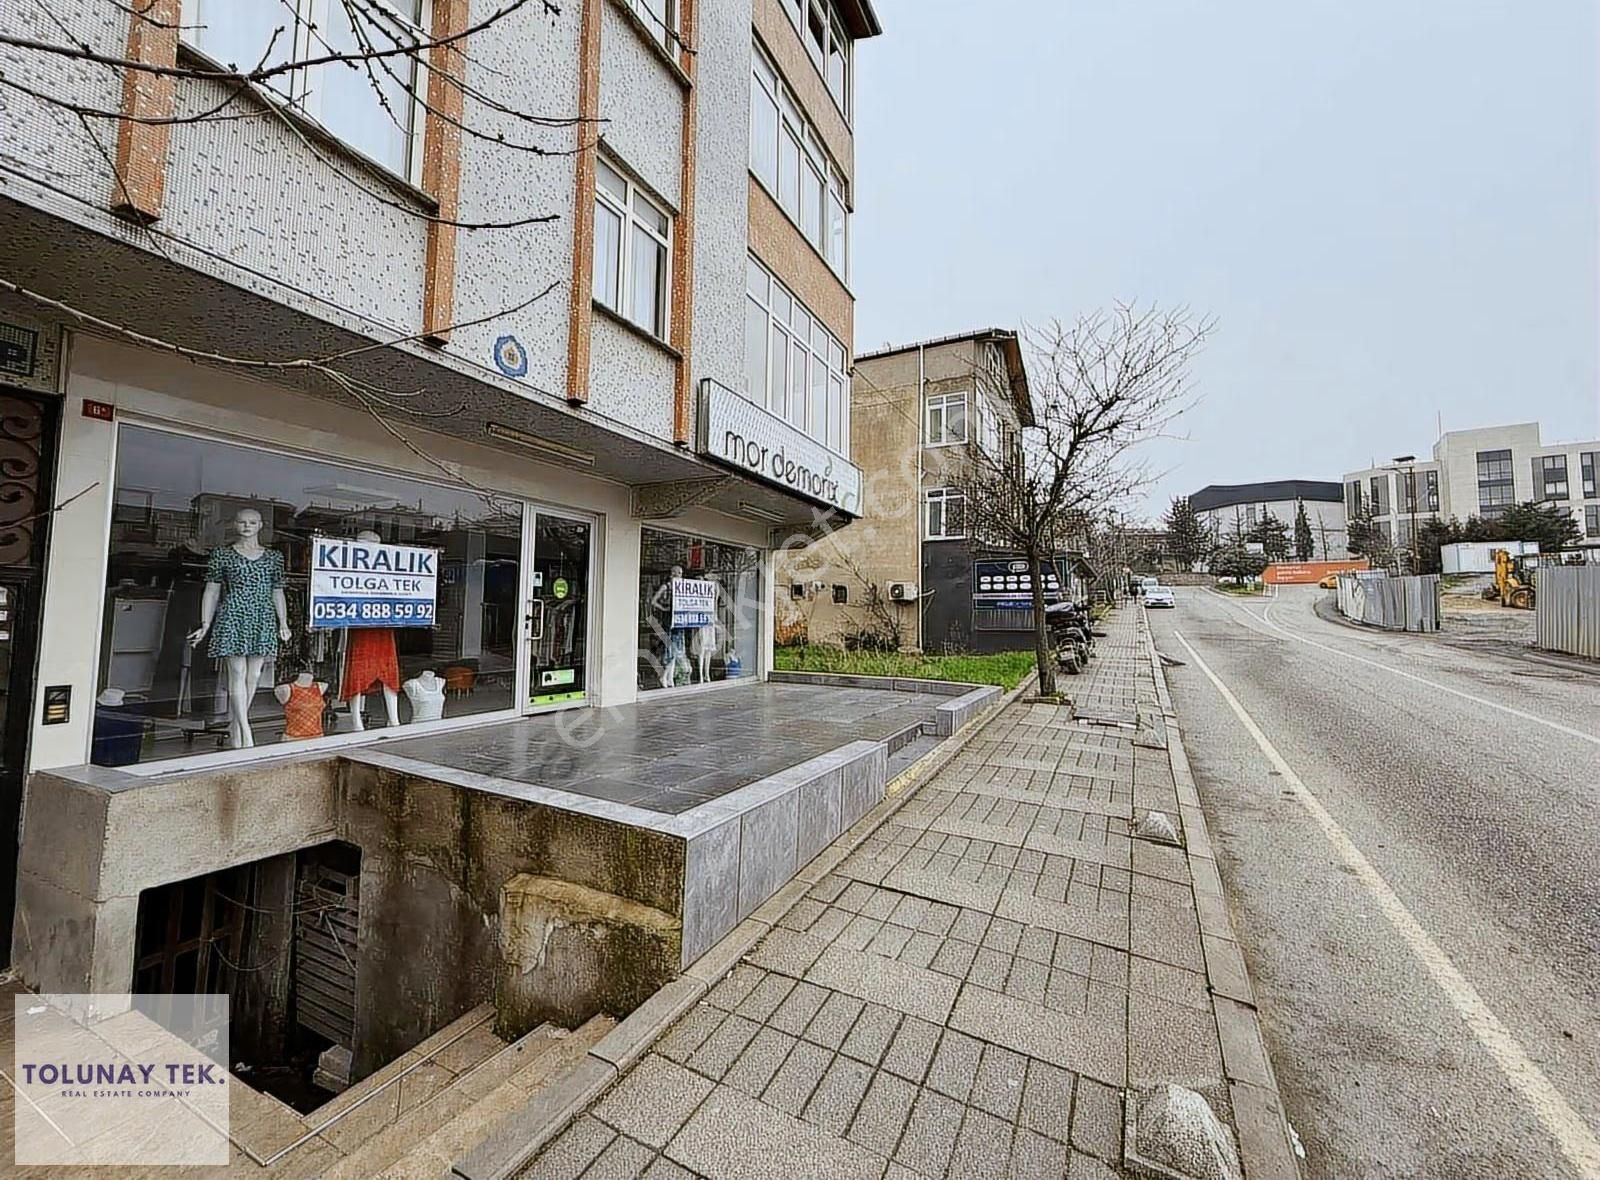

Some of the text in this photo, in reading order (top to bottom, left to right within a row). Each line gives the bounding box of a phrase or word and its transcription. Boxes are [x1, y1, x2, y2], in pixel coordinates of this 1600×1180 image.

[725, 431, 768, 472] mor
[319, 542, 433, 574] KİRALIK
[329, 576, 421, 592] TOLGA TEK
[315, 603, 433, 620] 0534 888 59 92
